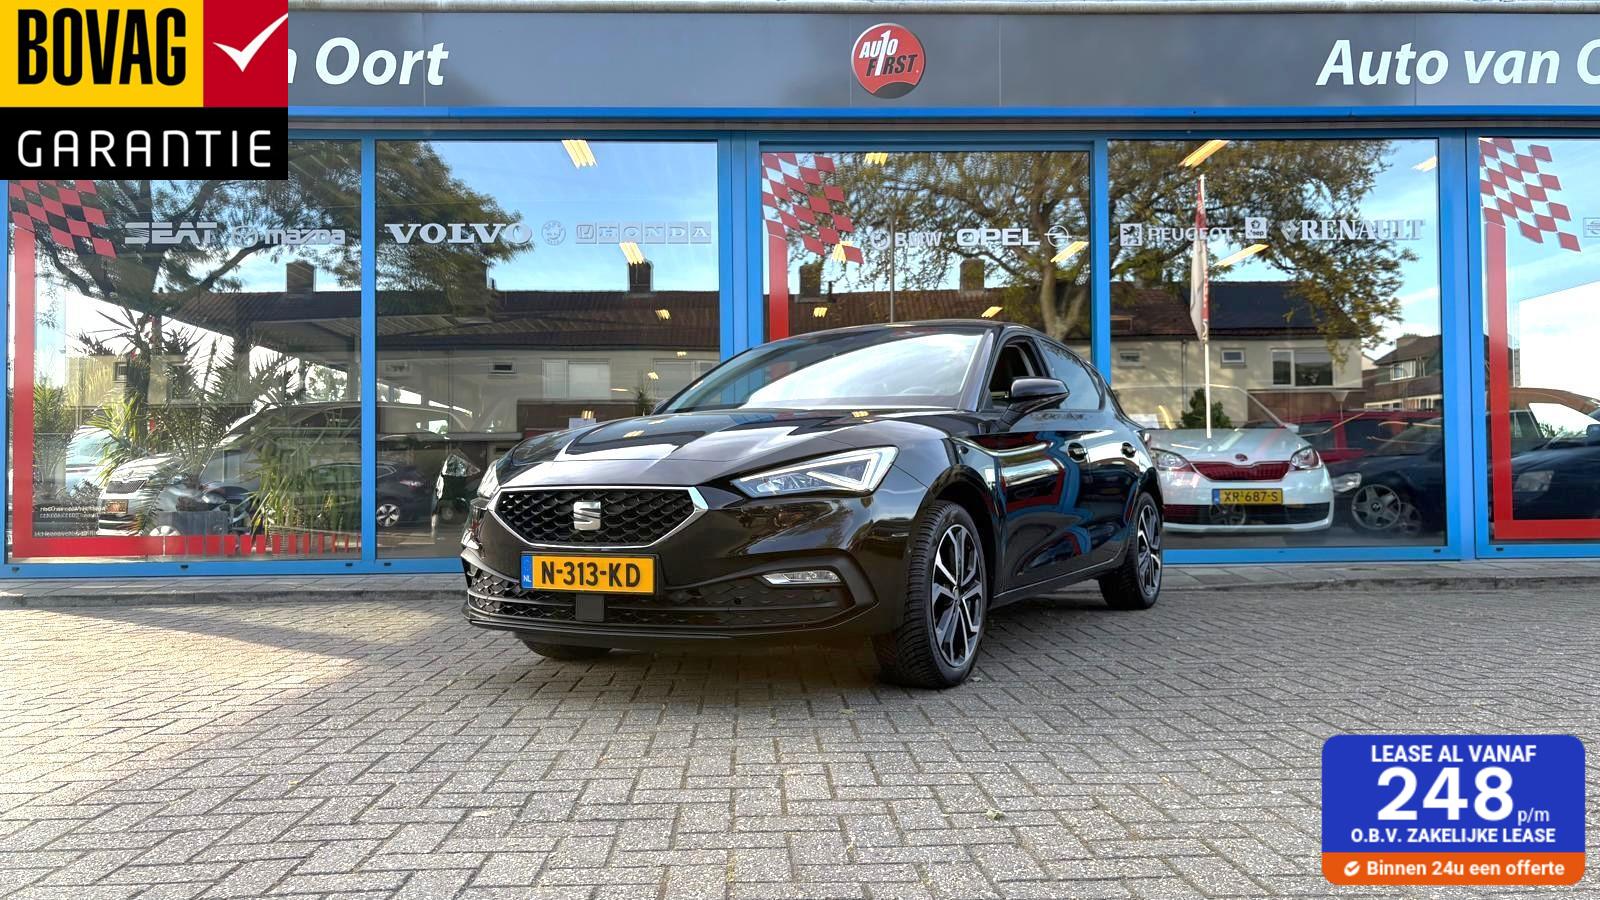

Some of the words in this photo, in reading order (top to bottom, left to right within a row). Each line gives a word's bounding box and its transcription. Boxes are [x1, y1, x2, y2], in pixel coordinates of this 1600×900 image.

[315, 37, 449, 85] Oort
[1315, 39, 1449, 86] Auto
[1464, 49, 1560, 85] van
[124, 222, 217, 244] SEAT
[265, 229, 346, 245] mazda
[385, 223, 533, 244] VOLVO
[598, 224, 712, 239] HONDA
[894, 231, 943, 247] BMW
[957, 228, 1040, 246] OPEL
[1148, 227, 1235, 241] PEUGEOT
[1300, 218, 1425, 240] RENAULT
[541, 561, 641, 588] N-313-KD
